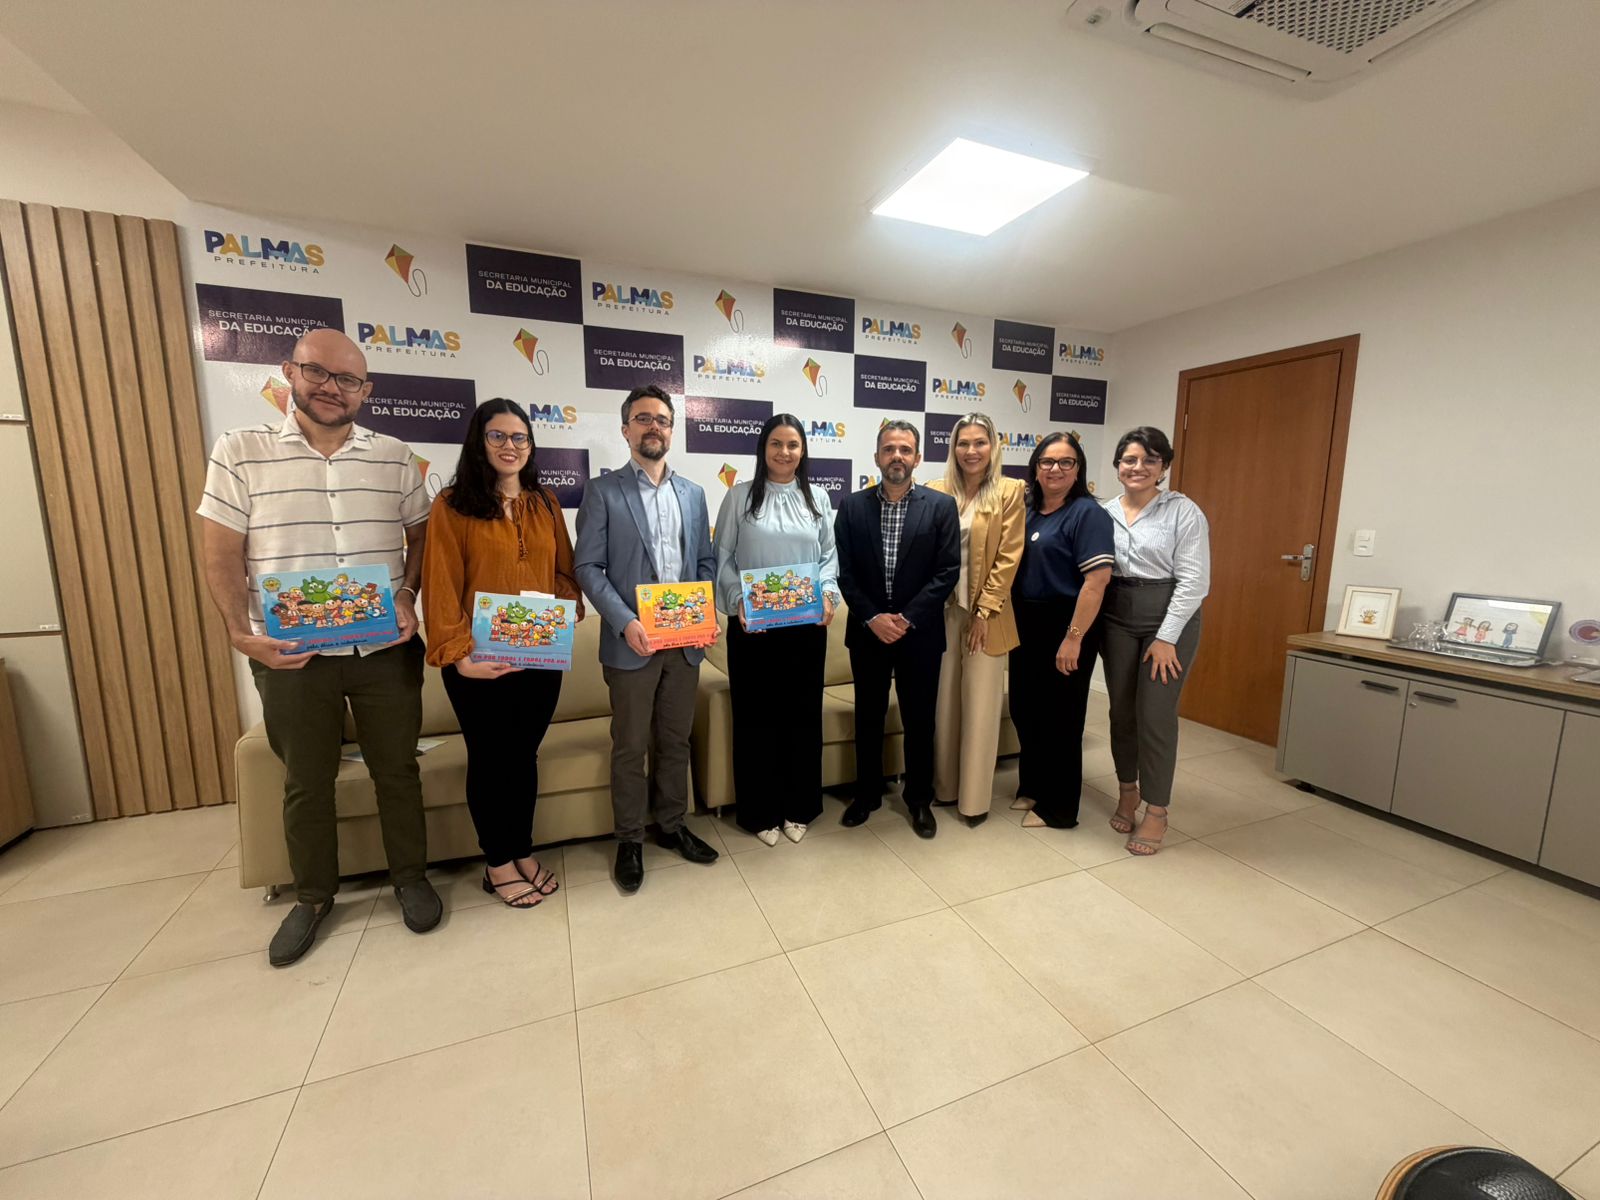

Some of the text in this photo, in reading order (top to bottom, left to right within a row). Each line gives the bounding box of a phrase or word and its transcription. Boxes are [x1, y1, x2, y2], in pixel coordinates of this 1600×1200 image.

[204, 230, 325, 267] PALMAS
[214, 256, 320, 274] PREFEITURA
[478, 271, 572, 289] SECRETARIA MUNICIPAL
[486, 279, 567, 298] DA EDUCAÇÃO
[592, 281, 674, 310] PALMAS
[597, 302, 670, 316] PREFEITURA
[208, 309, 329, 328] SECRETARIA MUNICIPAL
[781, 309, 848, 324] SECRETARIA MUNICIPAL
[219, 320, 311, 340] DA EDUCAÇÃ
[785, 317, 844, 332] DA EDUCAÇÃO
[862, 317, 921, 340] PALMAS
[358, 322, 461, 351] PALMAS
[865, 334, 918, 345] PREFEITURA
[999, 337, 1025, 346] SECRETARIA
[365, 345, 457, 359] PREFEITURA
[594, 348, 676, 362] SECRETARIA MUNICIPAL
[1002, 344, 1046, 357] DA EDUCAÇÃO
[1059, 343, 1105, 362] PALMAS
[600, 357, 671, 373] DA EDUCAÇÃO
[693, 354, 766, 379] PALMAS
[697, 373, 761, 384] PREFEITURA
[860, 373, 920, 385] SECRETARIA MUNICIPAL
[864, 381, 917, 393] DA EDUCAÇÃO
[932, 378, 986, 397] PALMAS
[363, 397, 466, 410] SECRETARIA MUNICIPAL
[935, 394, 982, 402] PREFEITURA
[1068, 398, 1099, 409] EDUCAÇÃO
[371, 405, 460, 421] DA EDUCAÇÃO
[694, 417, 732, 425] SECRETARIA
[698, 424, 762, 436] DA EDUCAÇÃO
[933, 436, 944, 445] DA
[540, 469, 581, 477] MUNICIPAL
